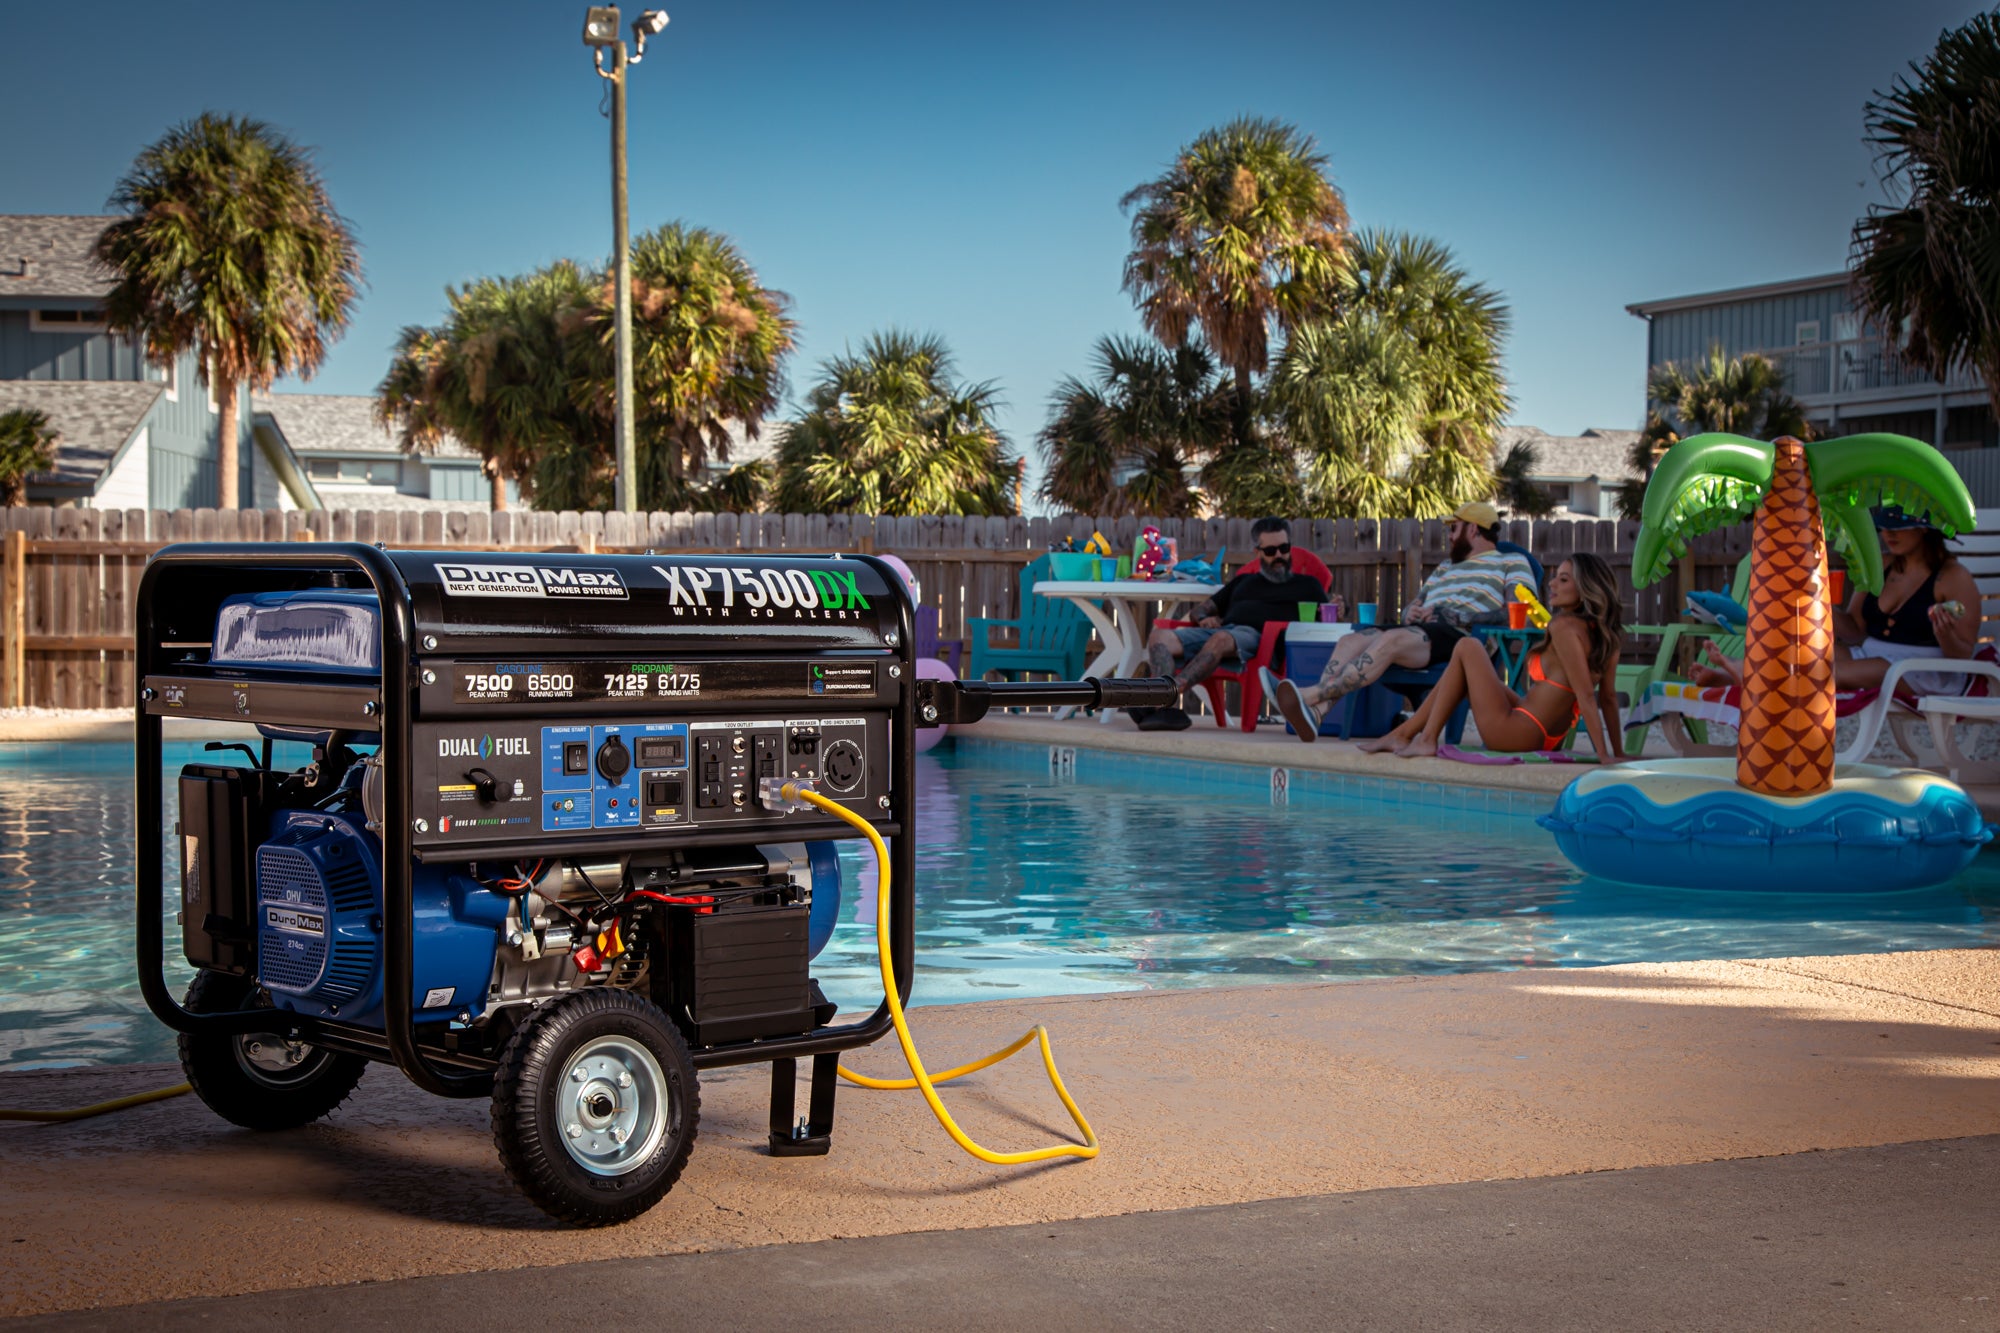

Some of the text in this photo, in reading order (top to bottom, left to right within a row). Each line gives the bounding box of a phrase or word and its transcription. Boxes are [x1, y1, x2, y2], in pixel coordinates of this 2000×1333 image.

[450, 584, 539, 593] NEXT GENERATION
[548, 586, 624, 596] POWER SYSTEMS
[652, 566, 871, 609] XP7500DX
[673, 607, 860, 619] WITH CO ALERT
[496, 664, 542, 674] GASOLINE
[631, 664, 673, 674] PROPANE
[465, 674, 513, 691] 7500
[528, 674, 574, 691] 6500
[604, 674, 648, 690] 7125
[658, 673, 700, 690] 6175
[439, 737, 531, 757] DUAL FUEL
[477, 818, 500, 826] PROPANE
[286, 890, 301, 902] OHV
